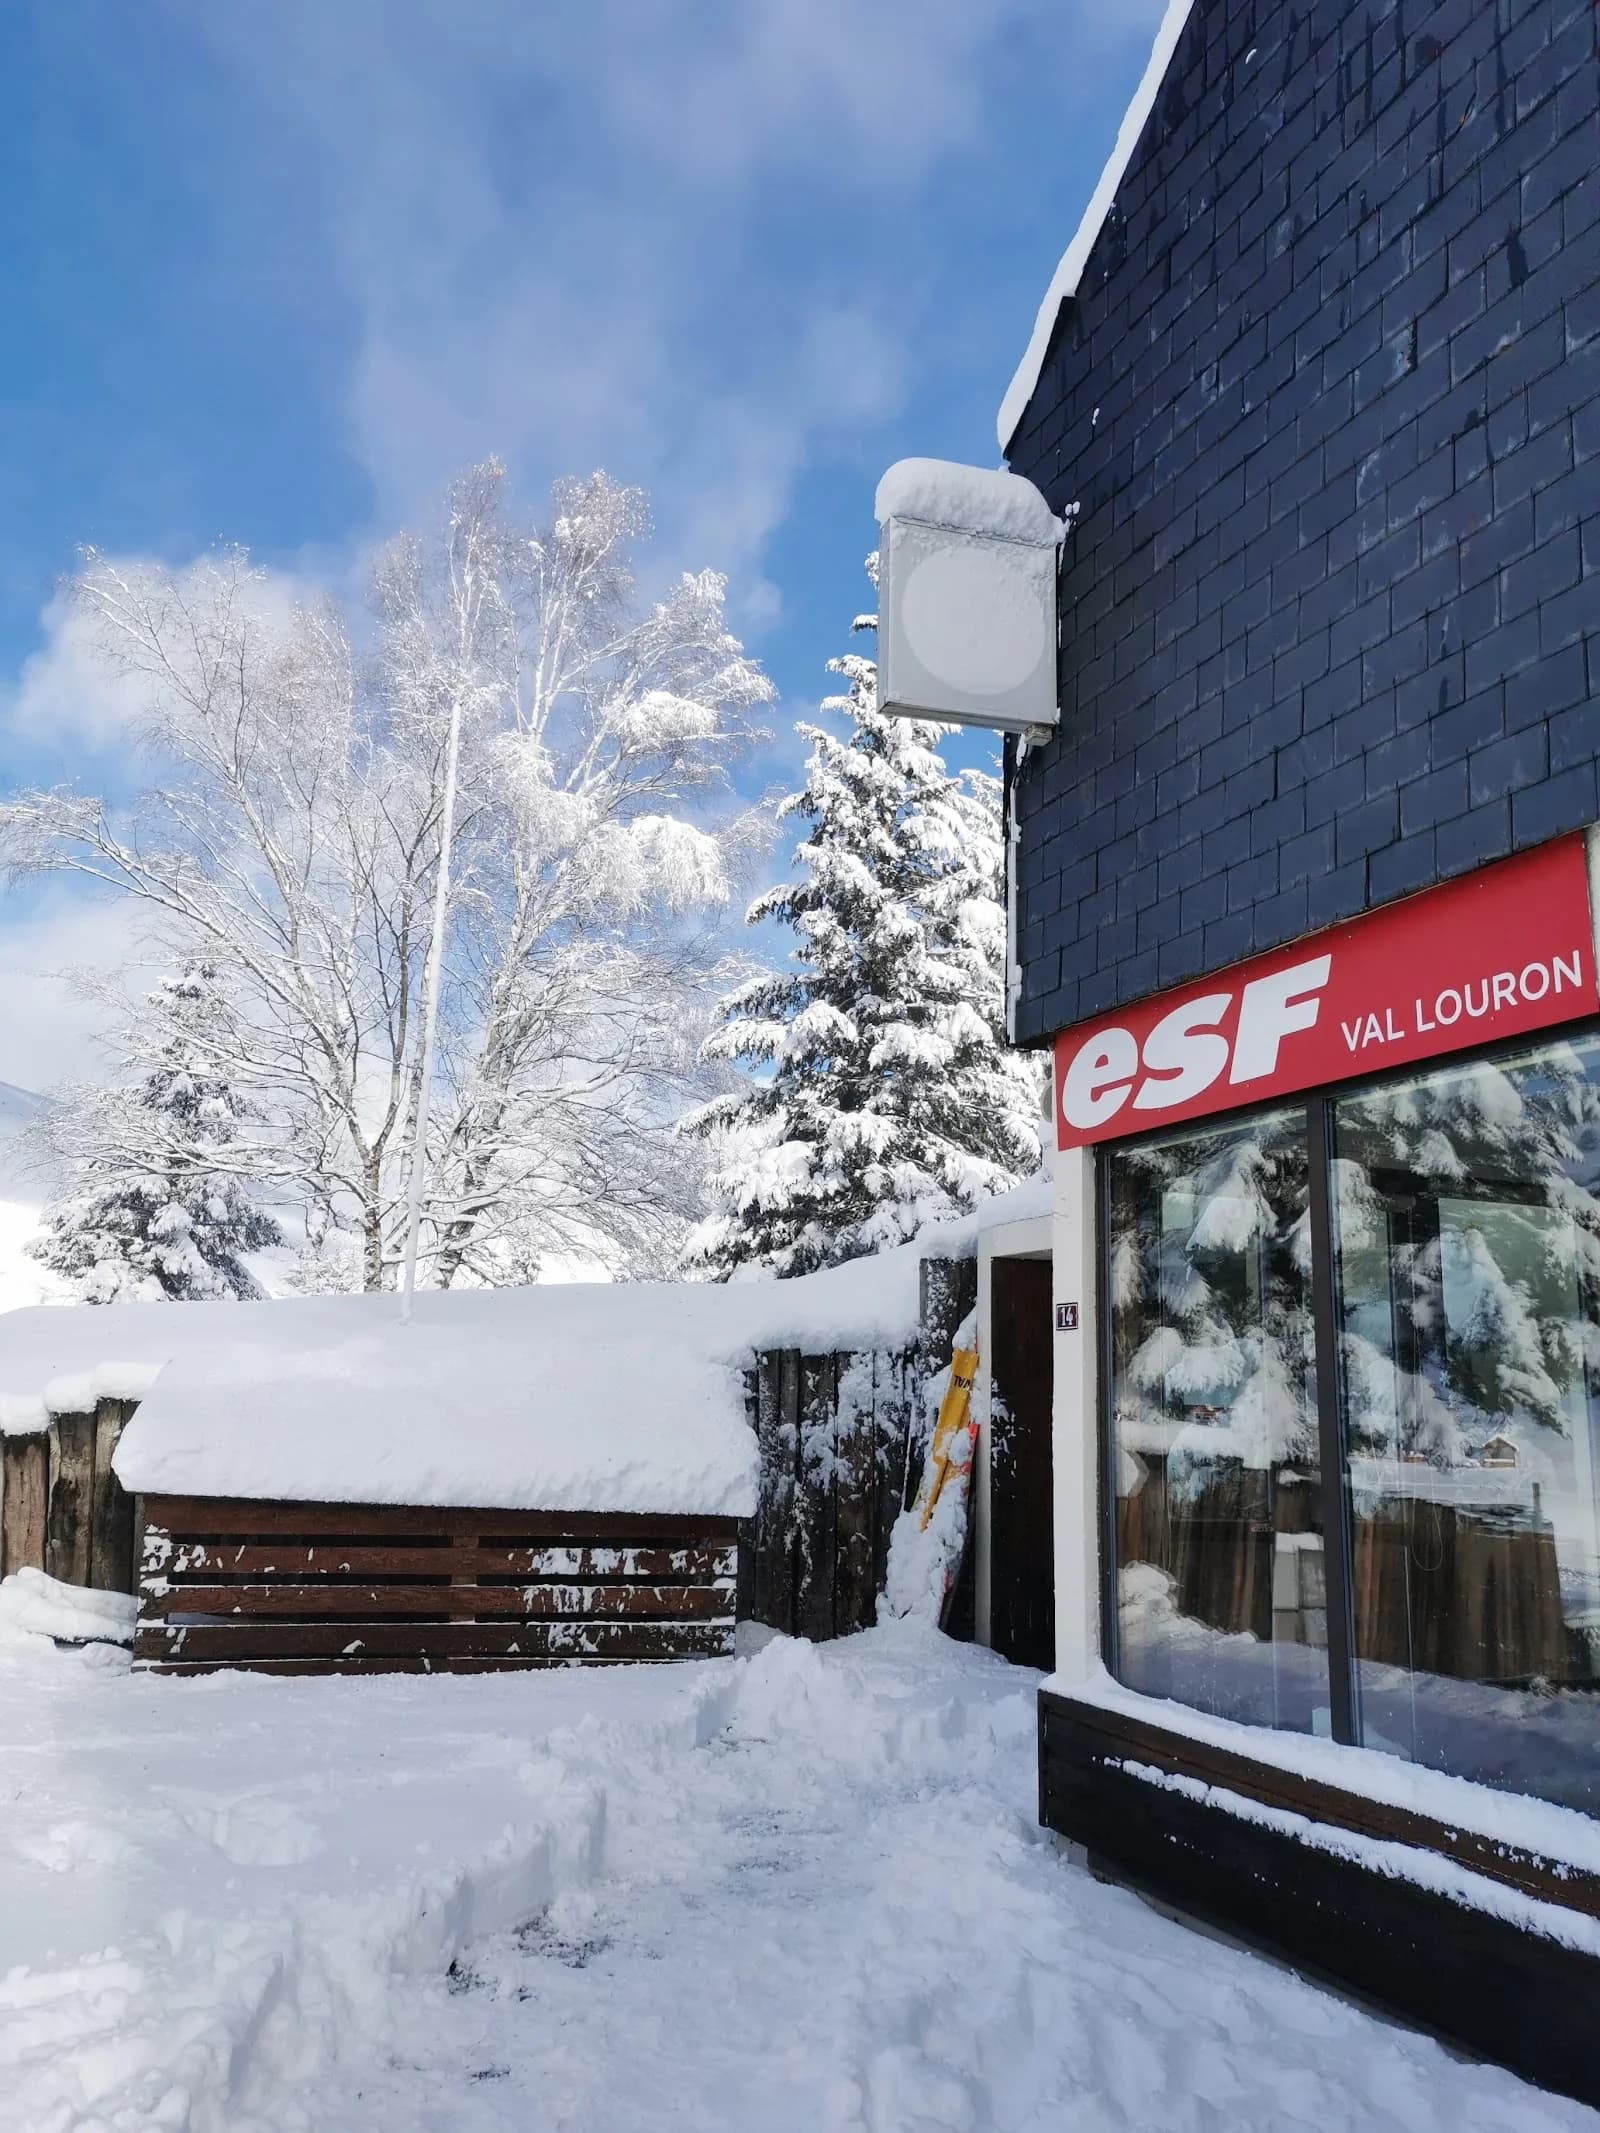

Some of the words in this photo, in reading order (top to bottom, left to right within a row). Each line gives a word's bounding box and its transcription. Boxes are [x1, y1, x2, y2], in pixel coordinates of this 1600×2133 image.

[1341, 1008, 1405, 1051] VAL
[1415, 950, 1582, 1033] LOURON
[1061, 1307, 1073, 1326] 14
